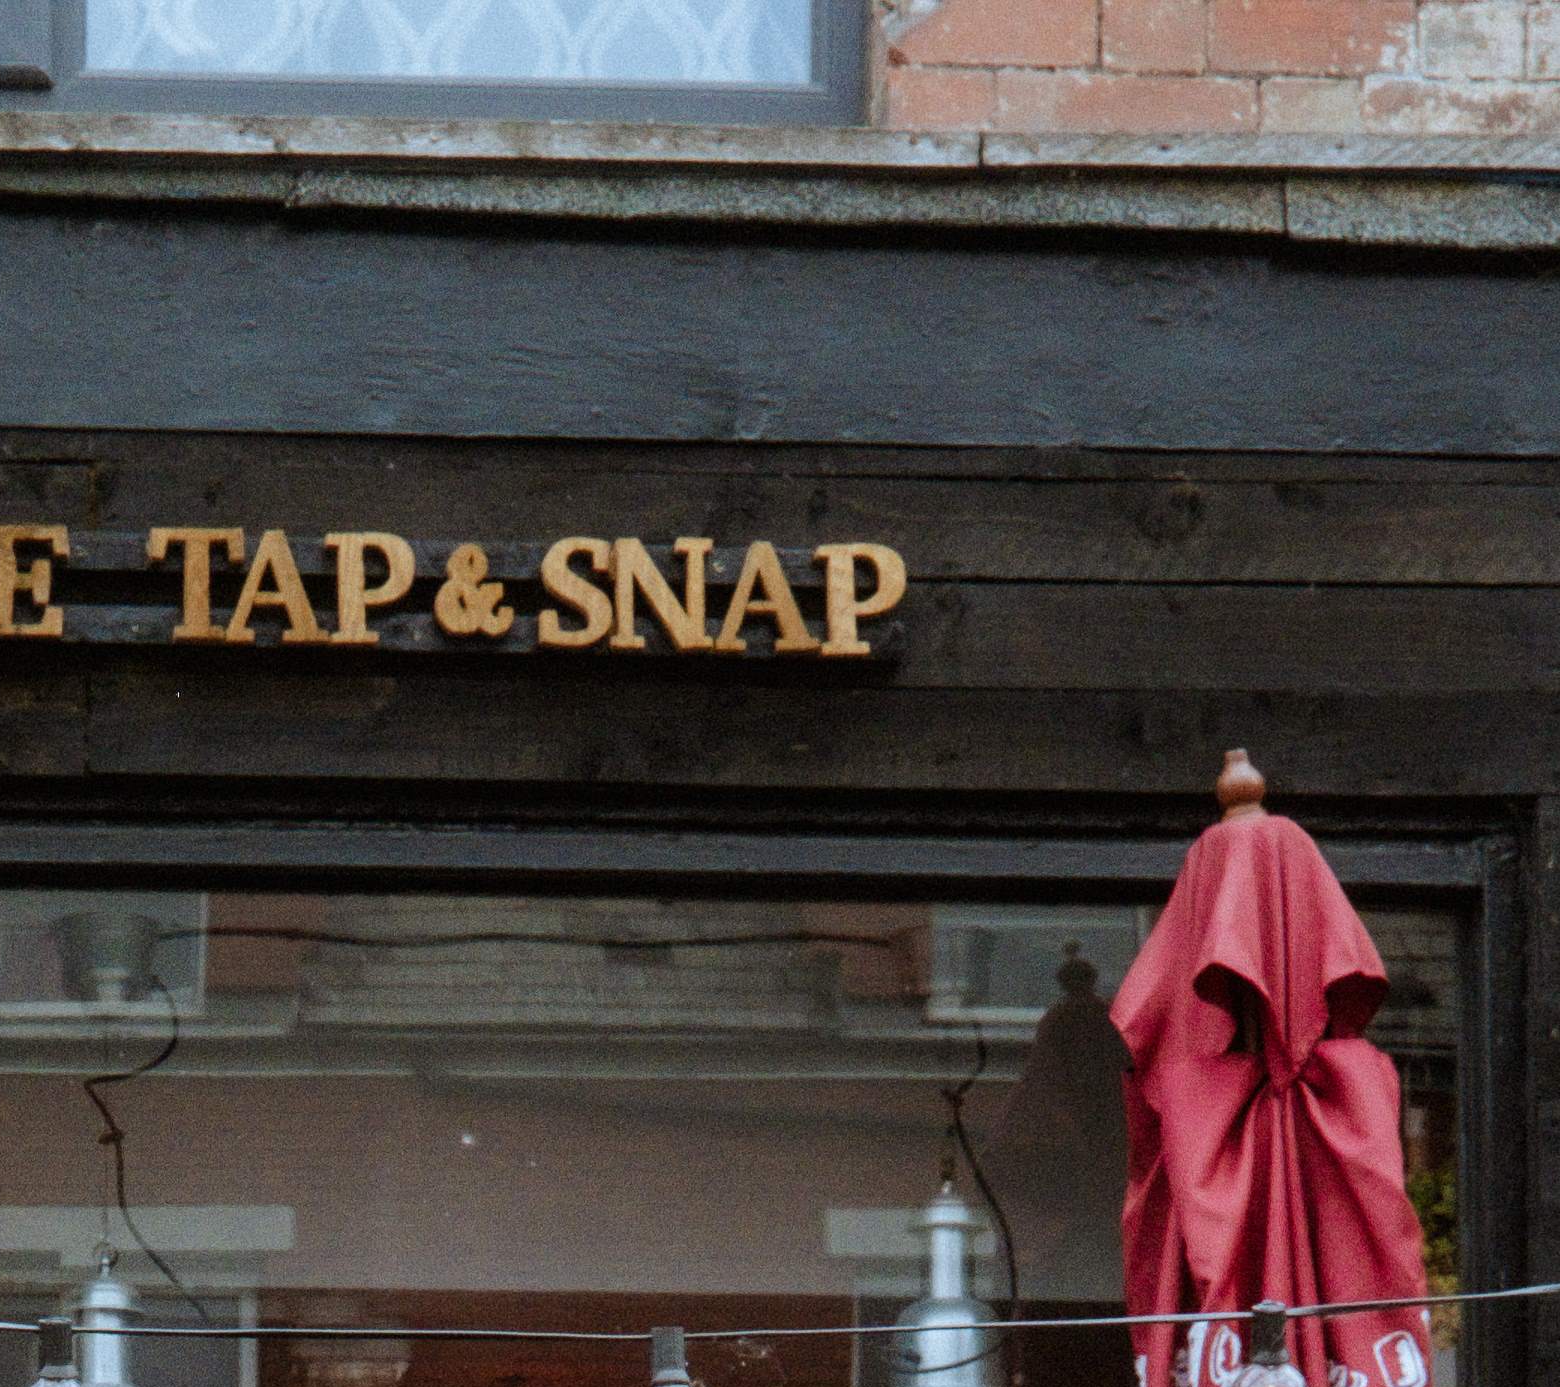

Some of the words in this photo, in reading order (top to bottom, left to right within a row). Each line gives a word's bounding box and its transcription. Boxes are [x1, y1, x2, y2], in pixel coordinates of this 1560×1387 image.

[147, 524, 416, 647] TAP
[433, 543, 515, 639] &
[537, 535, 908, 656] SNAP
